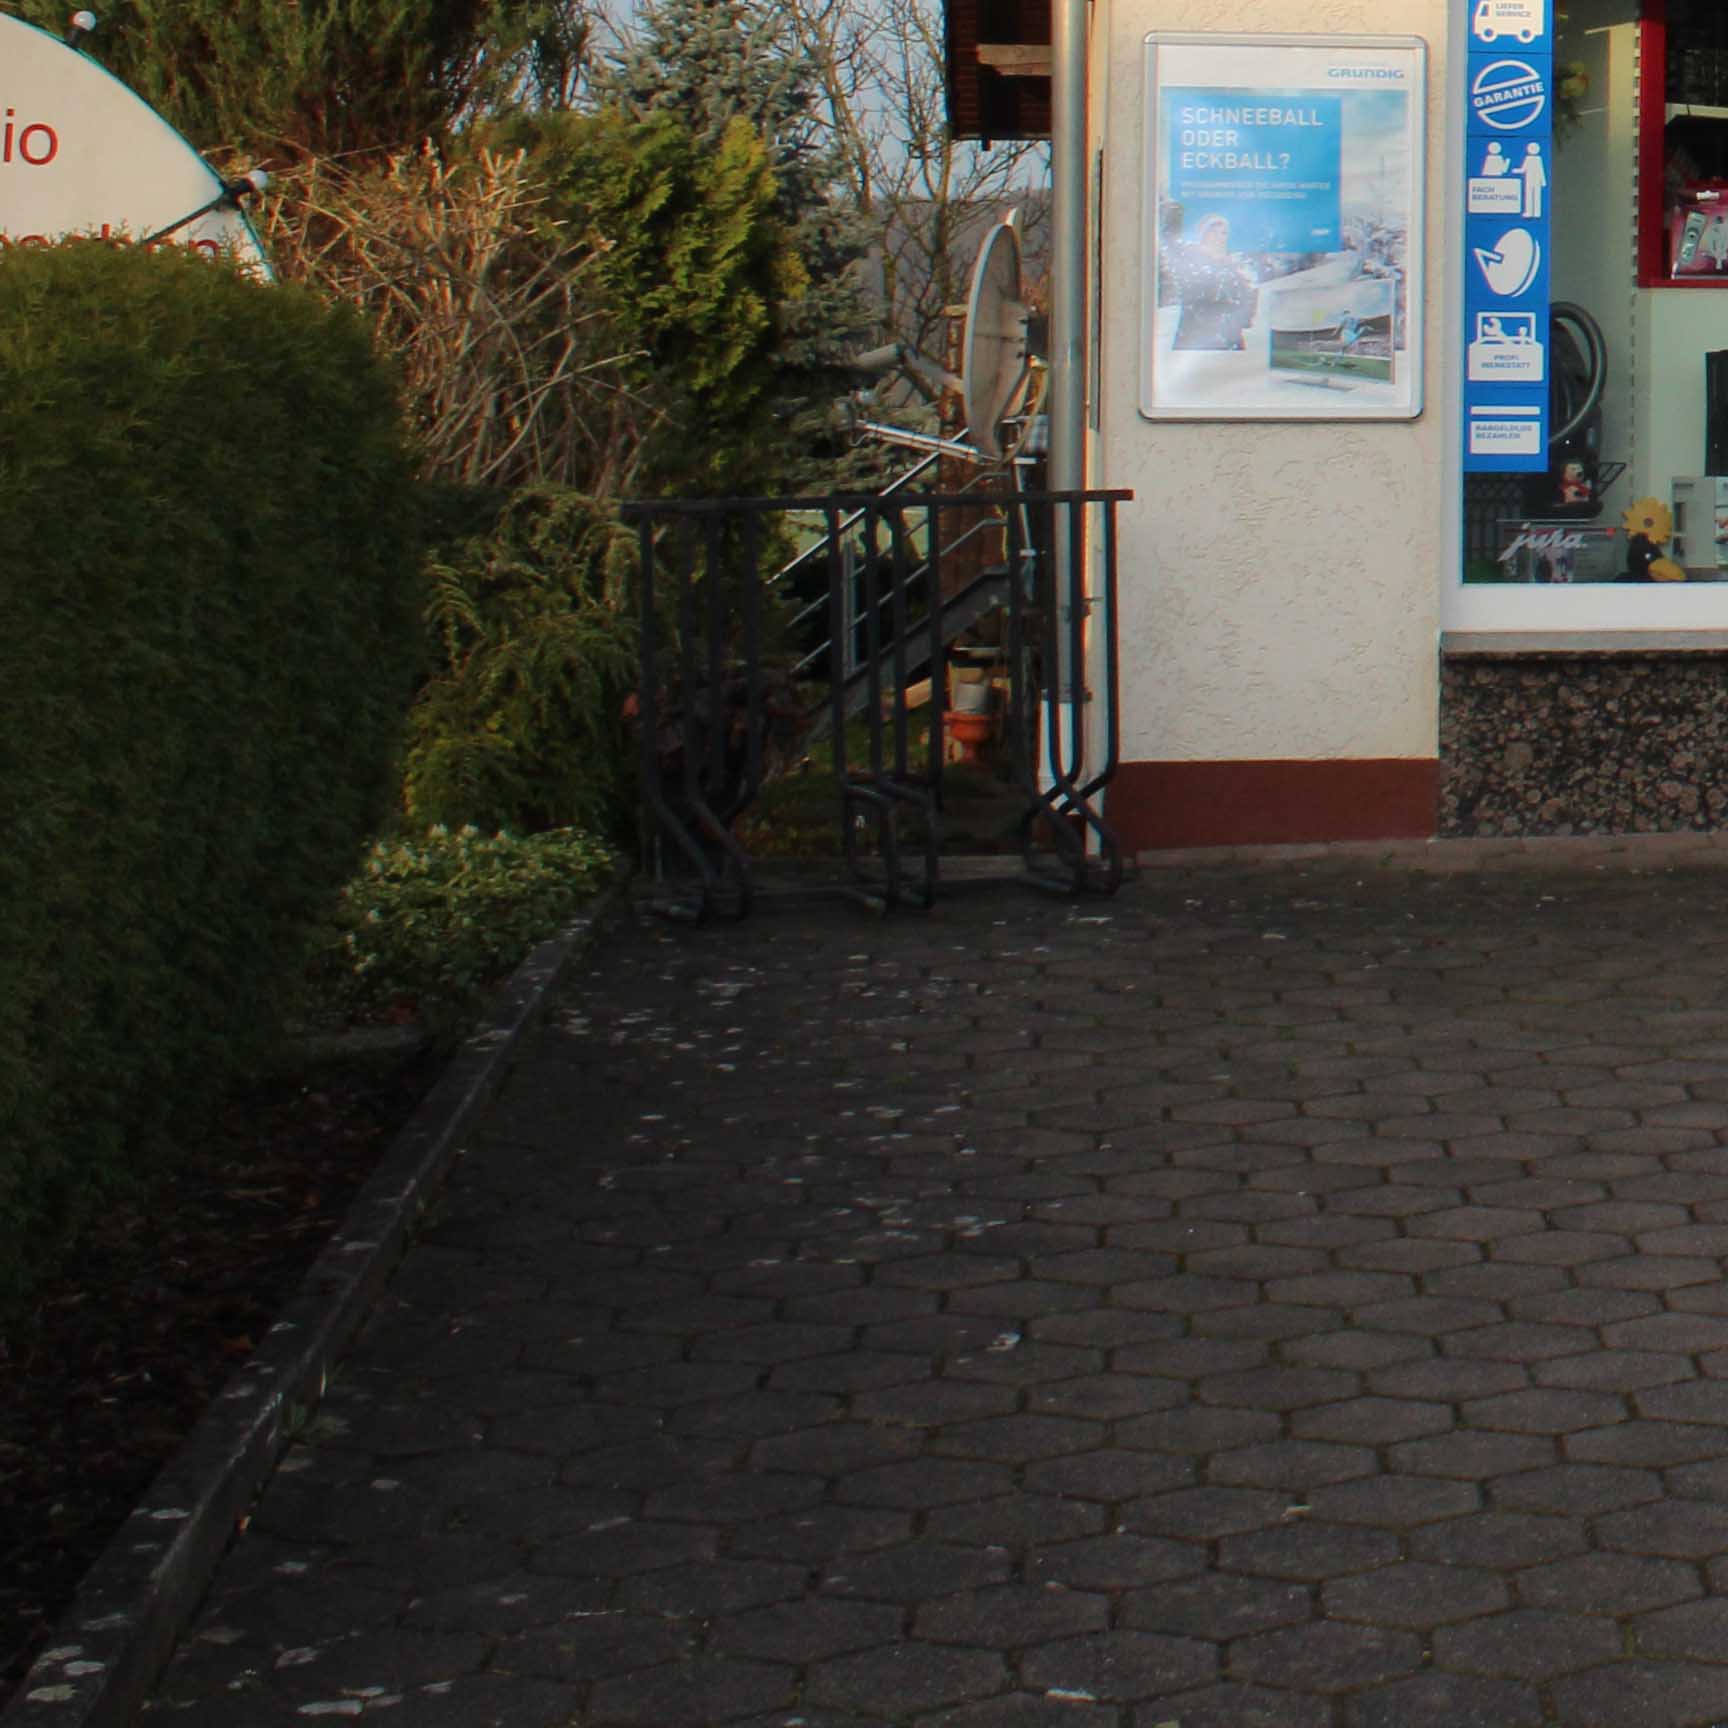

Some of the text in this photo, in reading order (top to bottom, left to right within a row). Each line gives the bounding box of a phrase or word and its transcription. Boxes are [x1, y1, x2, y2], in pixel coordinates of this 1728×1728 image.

[1328, 68, 1404, 79] GRUNDIG
[1474, 82, 1544, 107] GARANTIE
[1182, 107, 1324, 127] SCHNEEBALL
[1182, 129, 1238, 147] ODER
[1182, 152, 1291, 170] ECKBALL?
